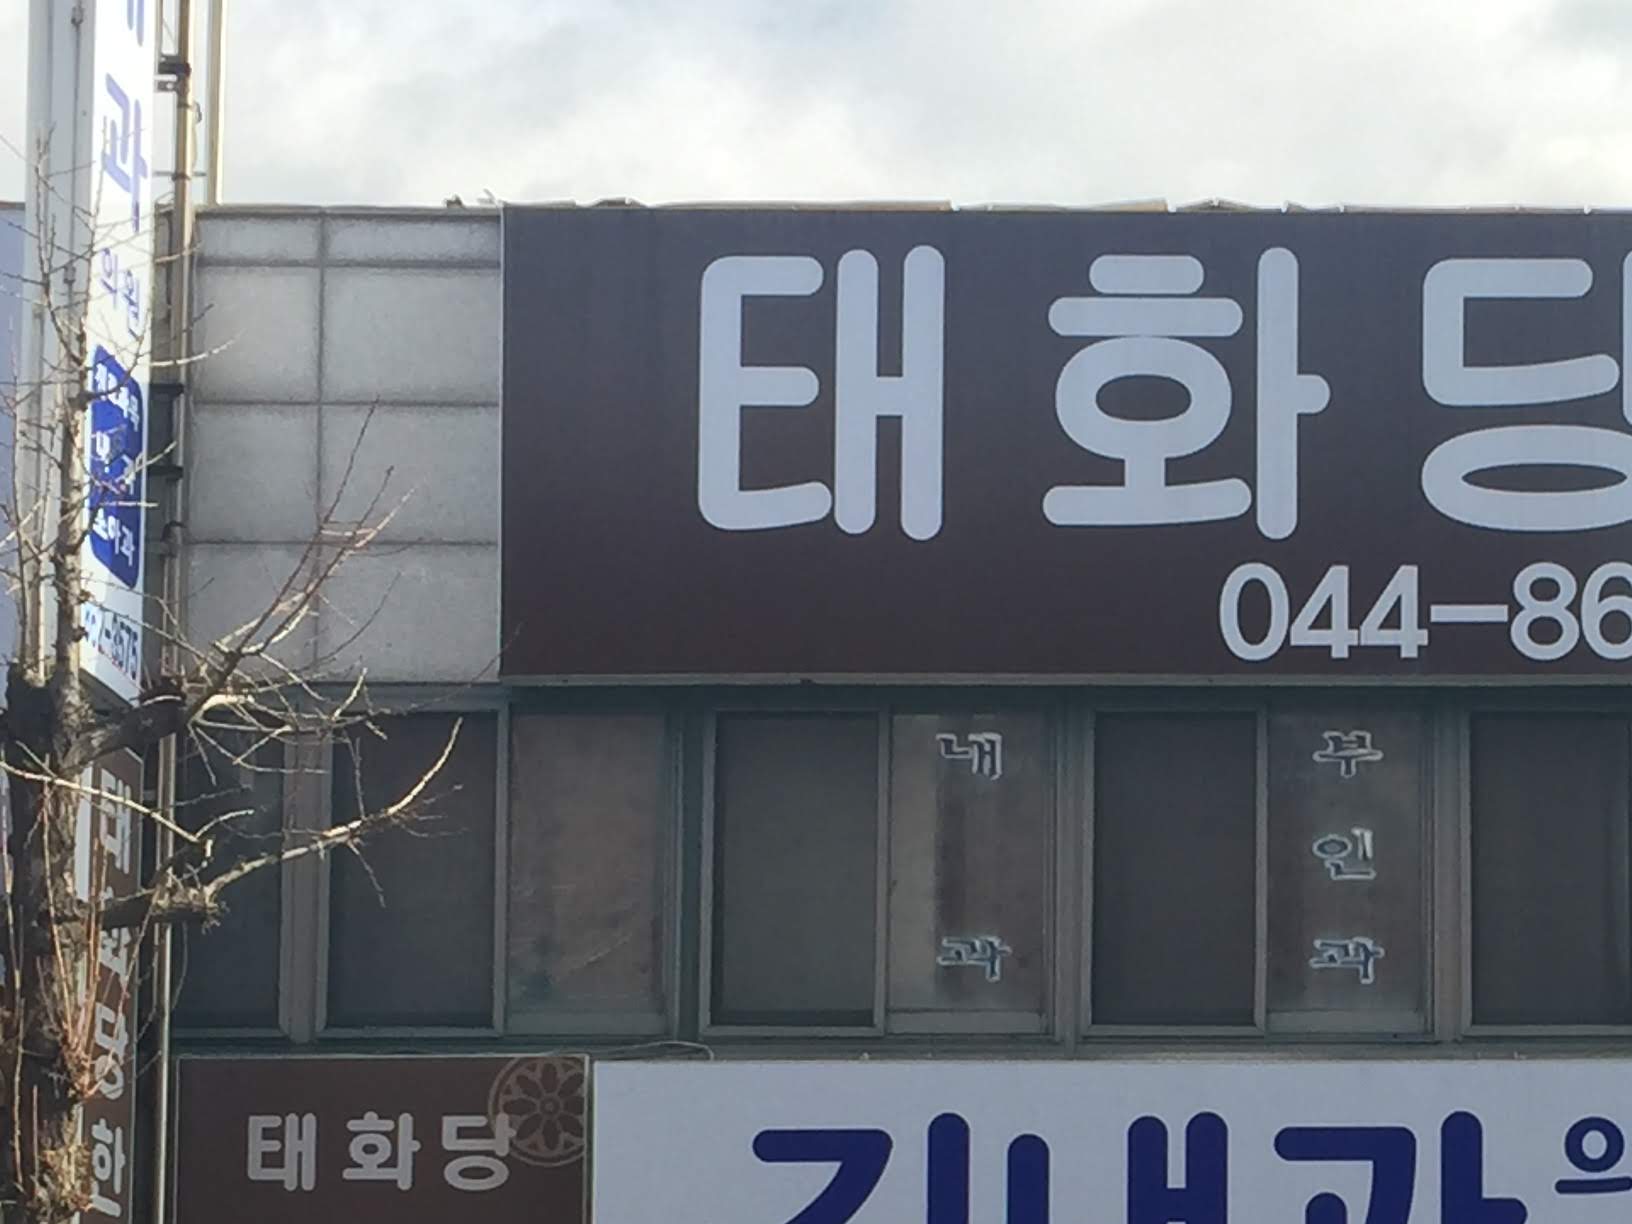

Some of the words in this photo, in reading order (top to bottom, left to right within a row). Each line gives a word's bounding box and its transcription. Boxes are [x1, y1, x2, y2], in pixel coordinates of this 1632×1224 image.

[936, 732, 1012, 983] 내과
[1310, 730, 1384, 985] 부인과
[247, 1111, 517, 1191] 태화당
